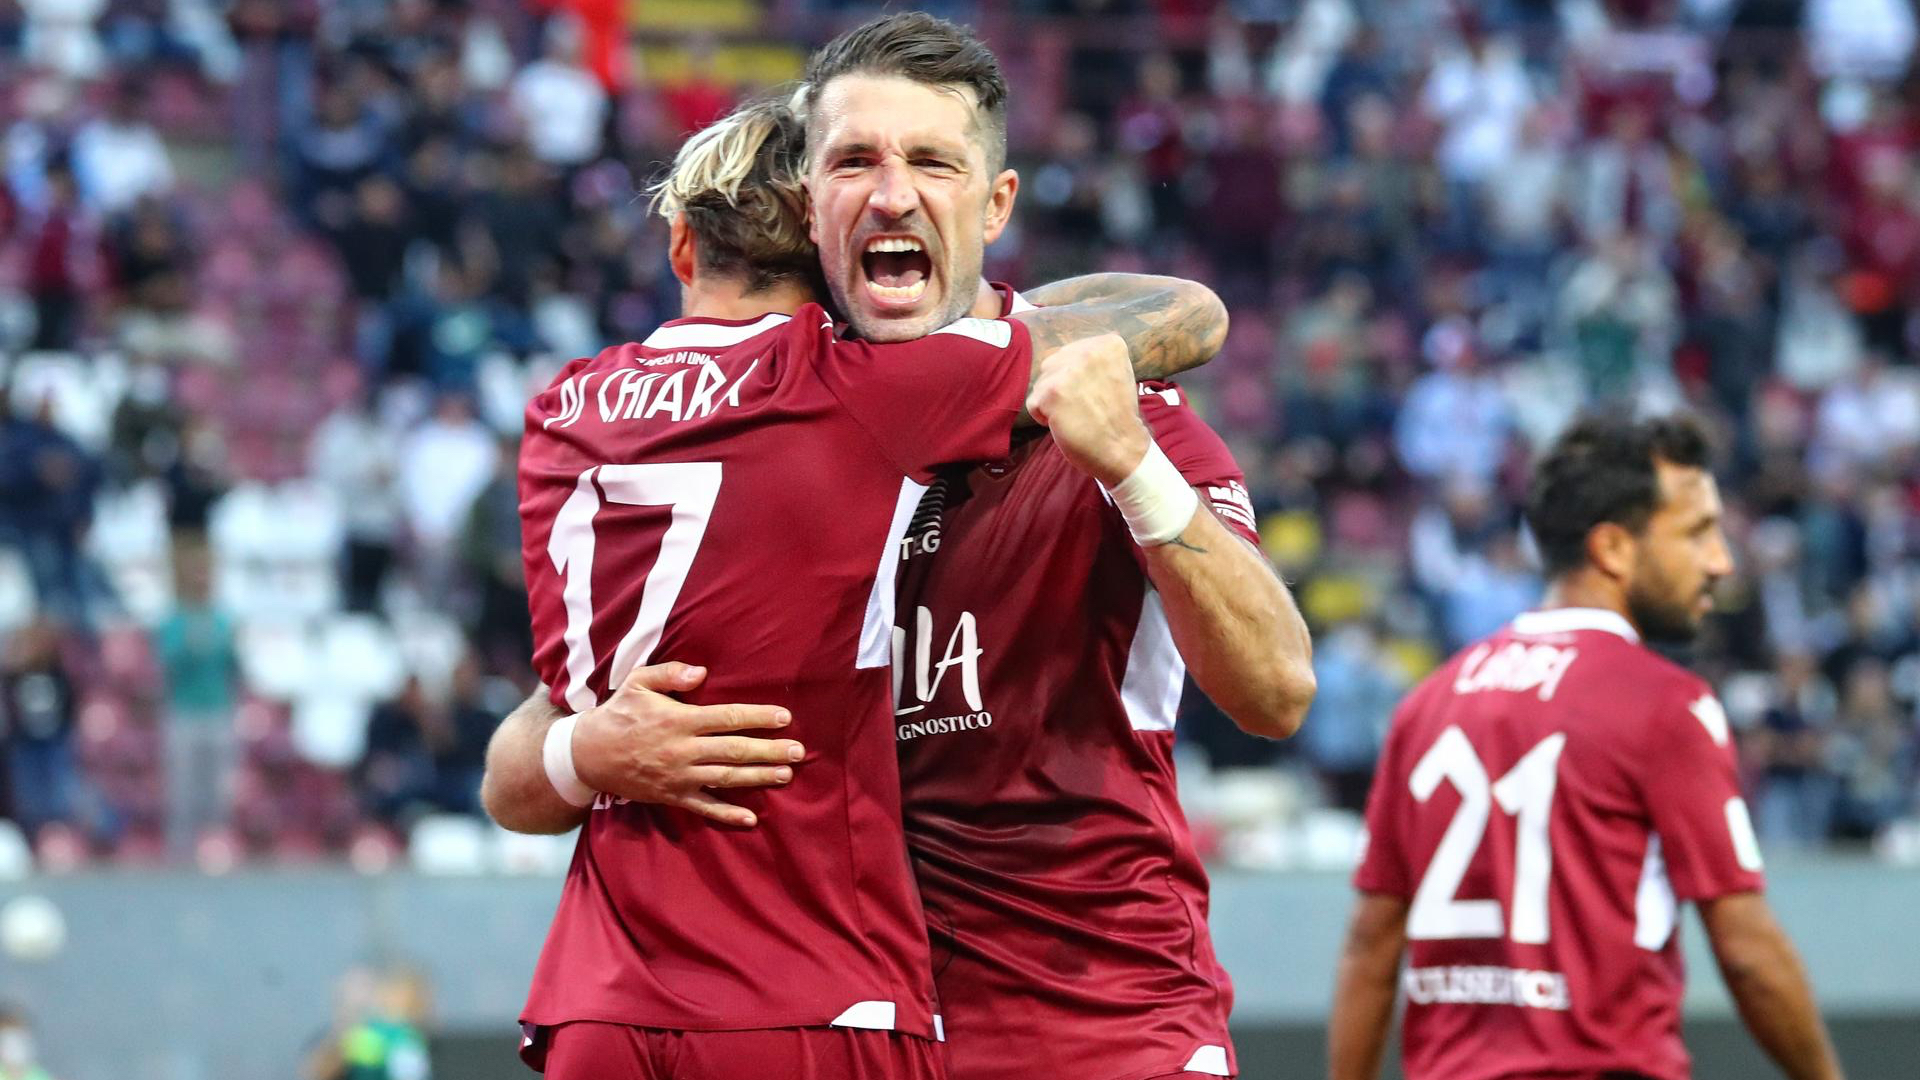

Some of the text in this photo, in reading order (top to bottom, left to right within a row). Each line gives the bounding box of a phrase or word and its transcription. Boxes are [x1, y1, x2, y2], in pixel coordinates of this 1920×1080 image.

[547, 462, 723, 713] 17
[896, 711, 992, 741] GNOSTICO
[1406, 724, 1566, 944] 21
